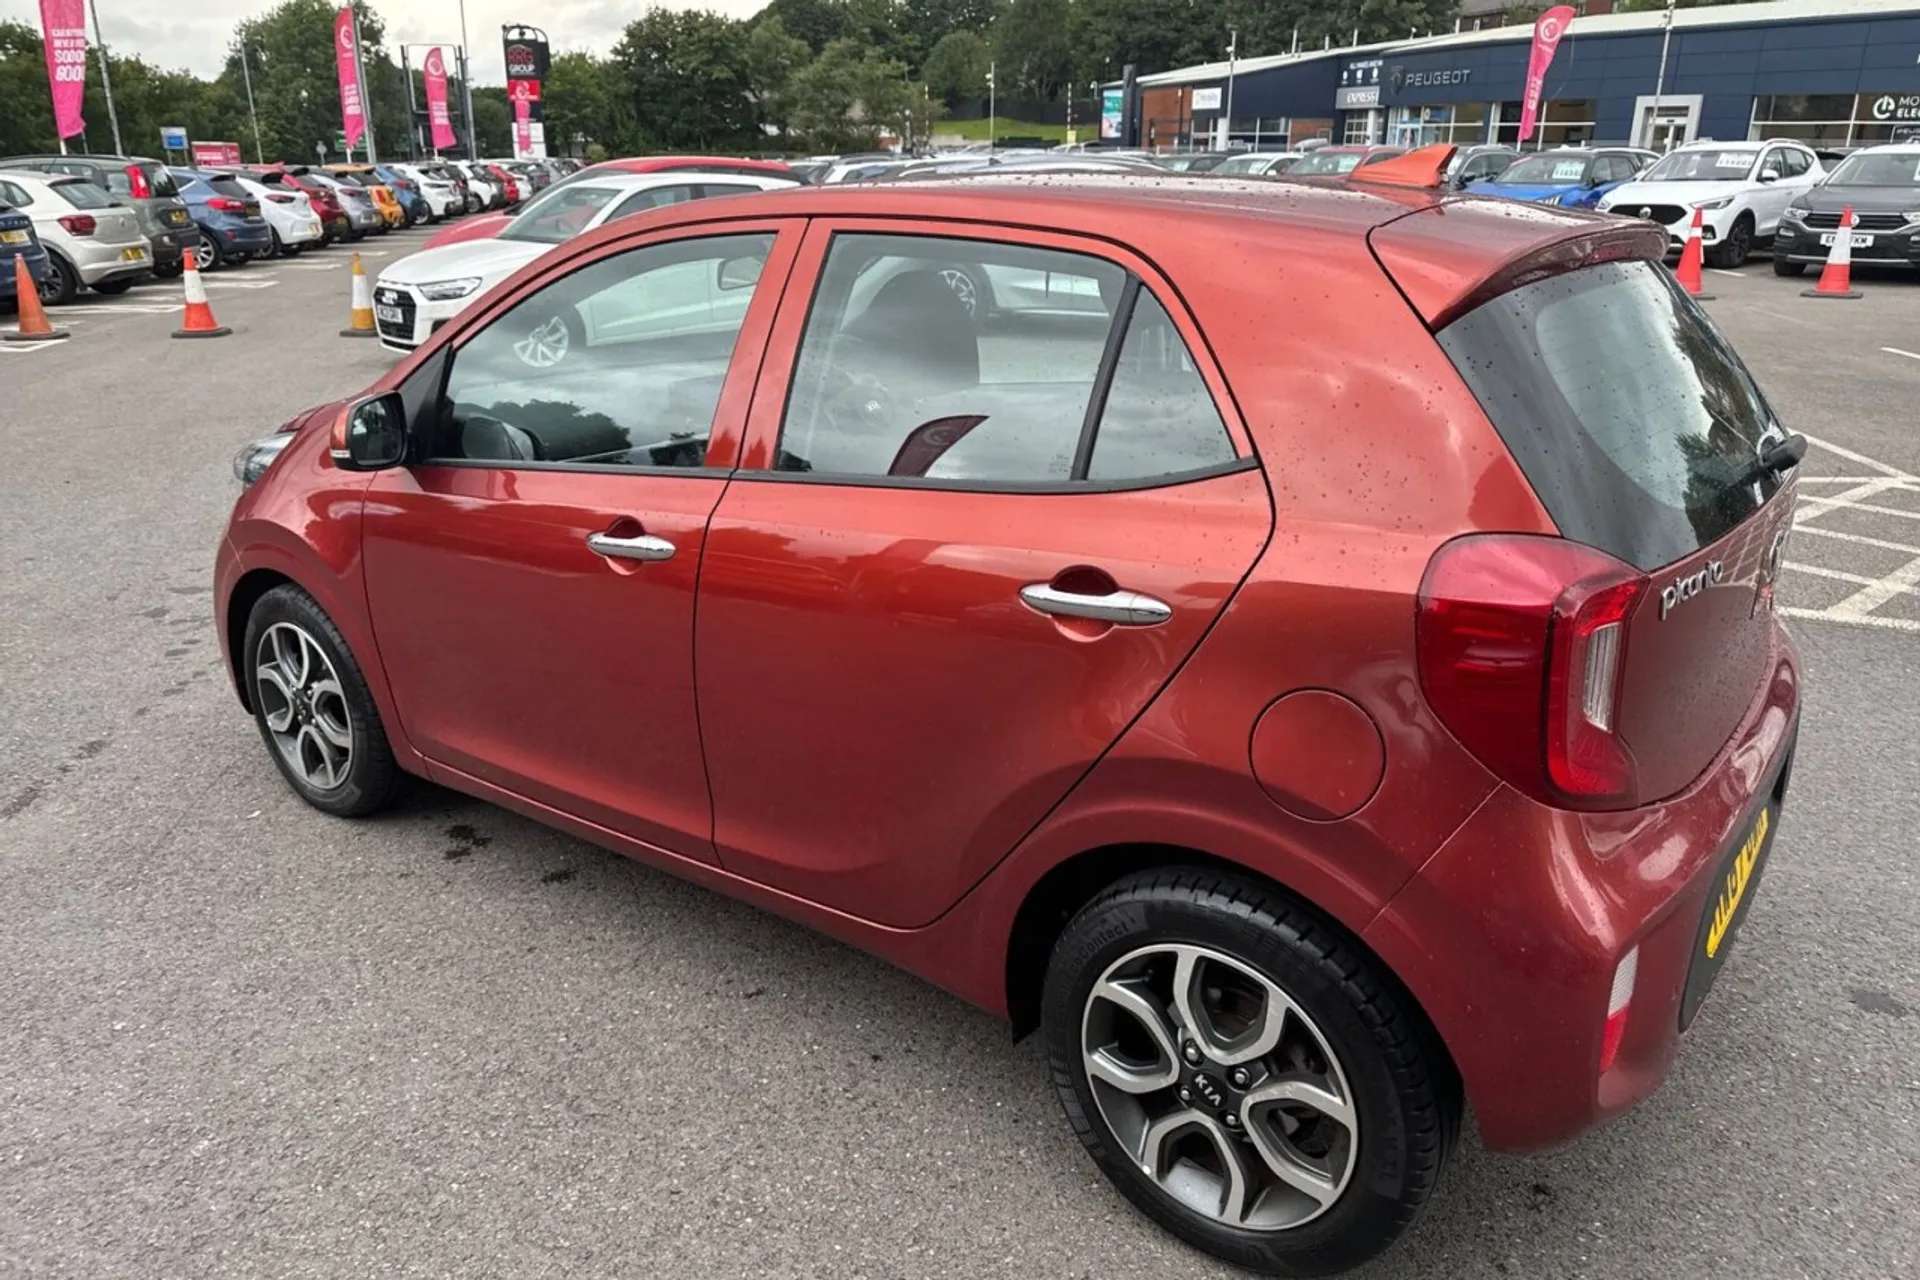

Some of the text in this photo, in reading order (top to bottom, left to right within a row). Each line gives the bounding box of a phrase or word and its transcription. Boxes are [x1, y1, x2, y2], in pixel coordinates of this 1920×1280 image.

[1404, 69, 1471, 87] PEUGEOT
[1661, 559, 1723, 621] picanto
[1194, 1073, 1222, 1107] KIA
